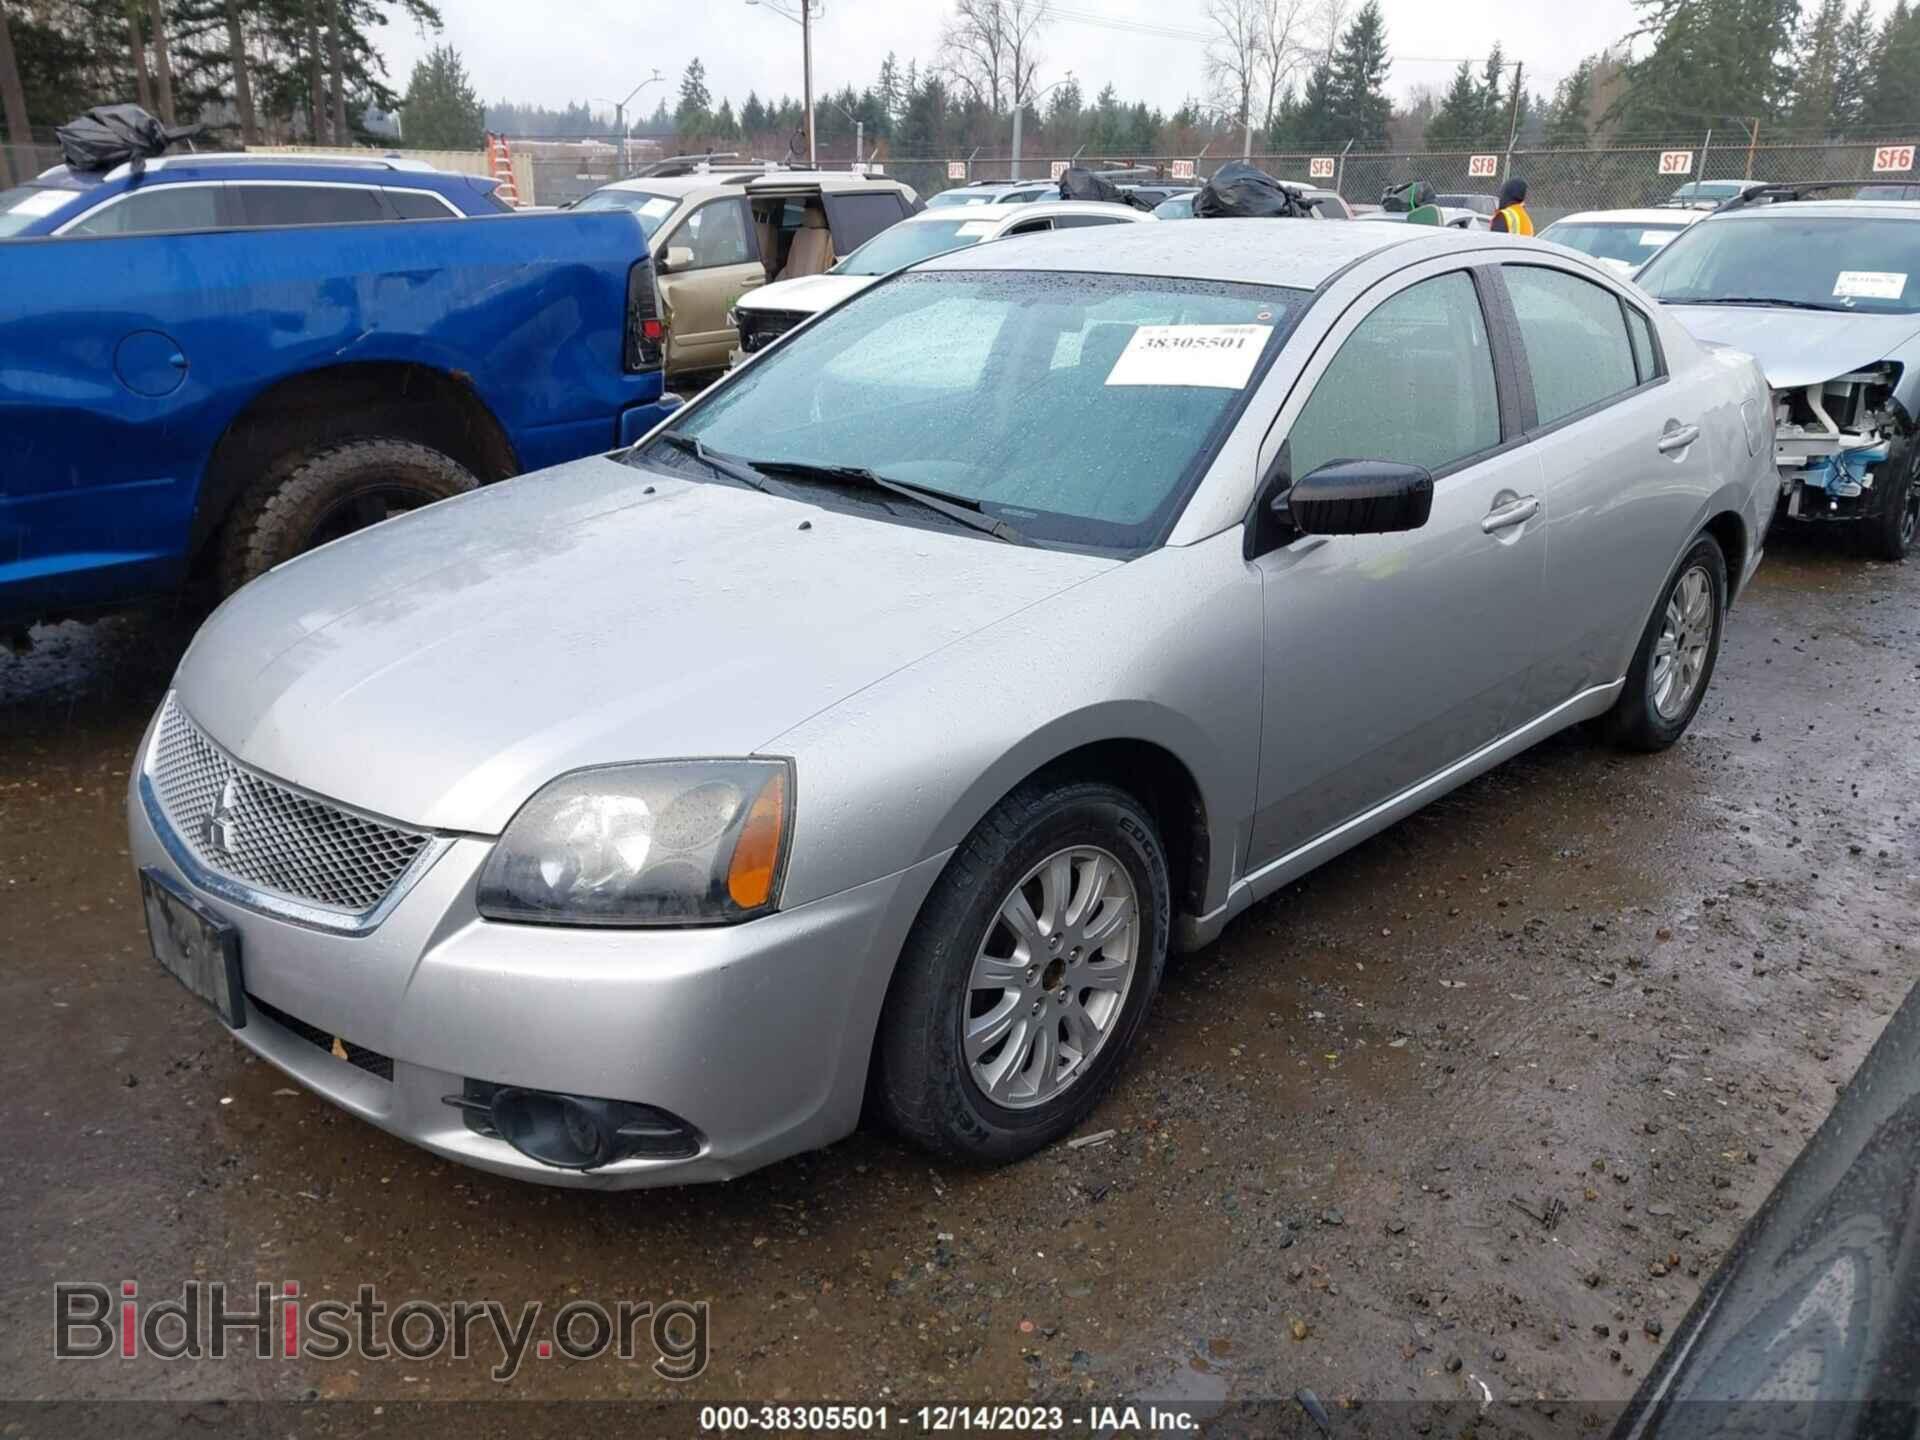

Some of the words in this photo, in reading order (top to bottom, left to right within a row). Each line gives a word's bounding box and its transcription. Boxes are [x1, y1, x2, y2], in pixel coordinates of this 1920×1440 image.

[1472, 158, 1494, 173] SF8
[1663, 154, 1688, 171] SF7
[1877, 149, 1910, 168] SF6
[1312, 159, 1332, 175] SF9
[1139, 336, 1246, 350] 38305501
